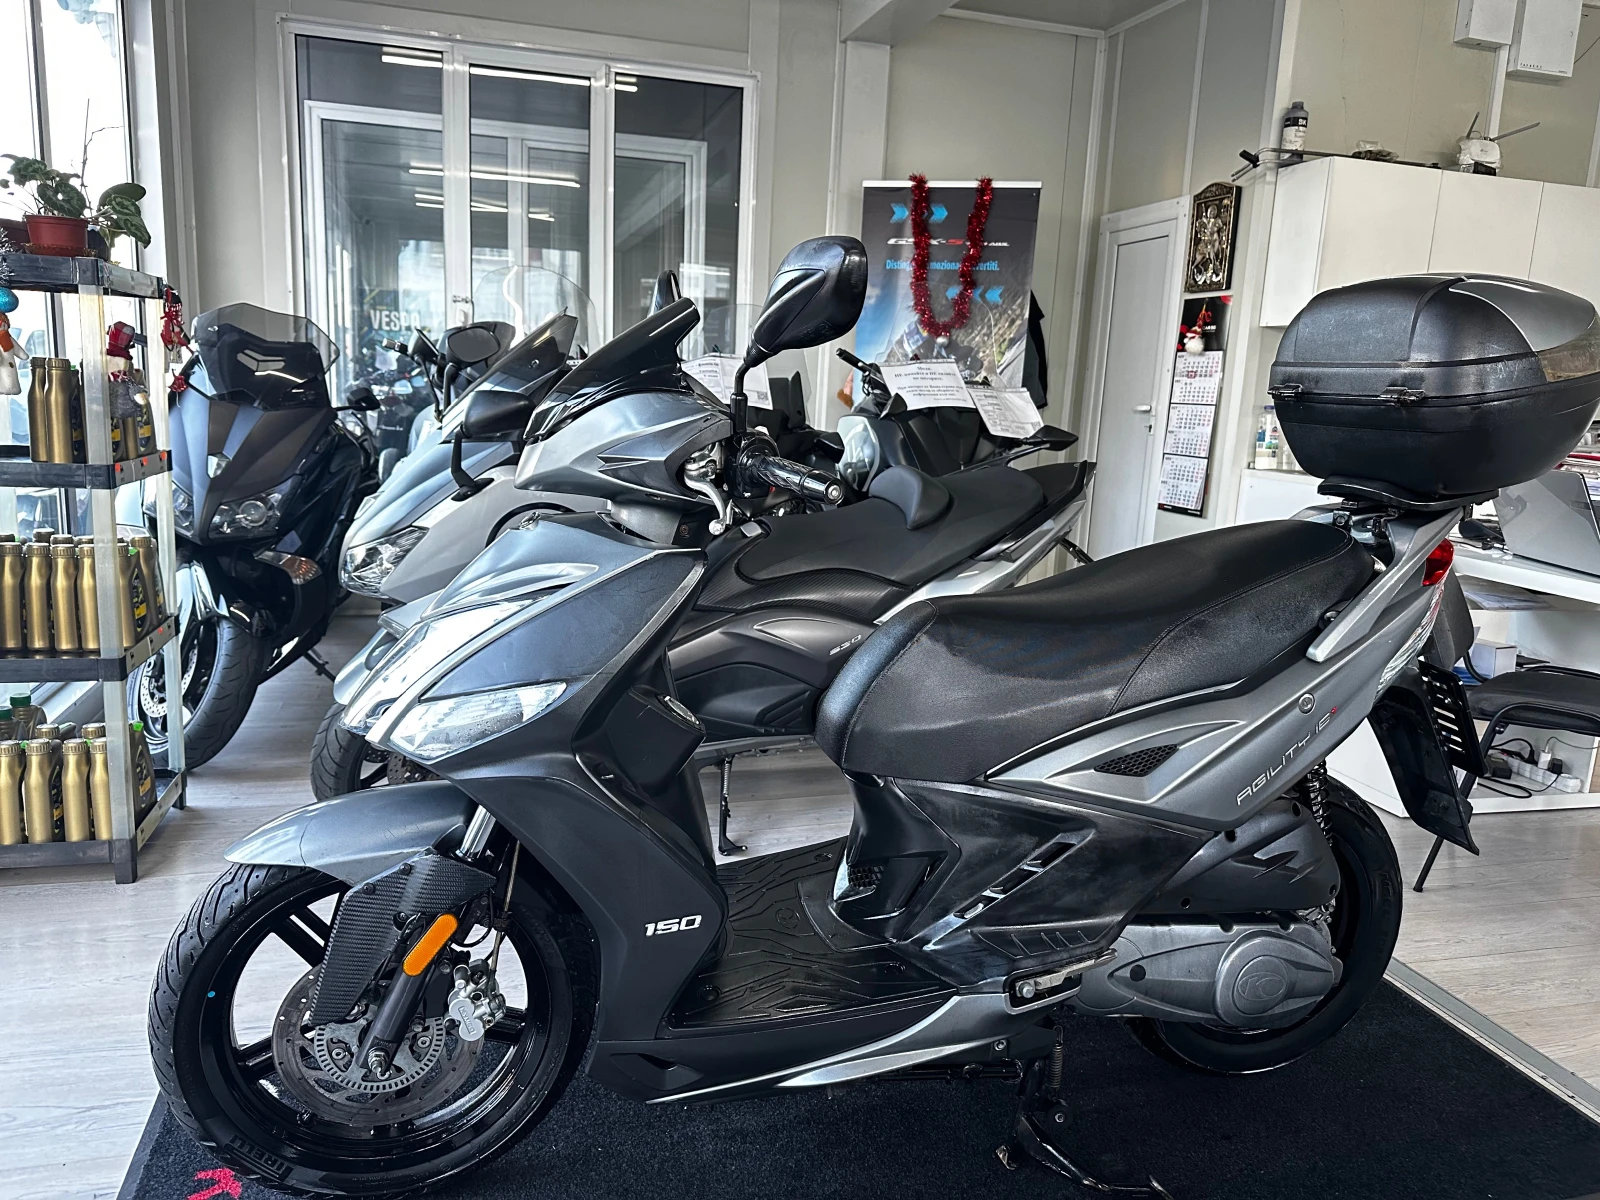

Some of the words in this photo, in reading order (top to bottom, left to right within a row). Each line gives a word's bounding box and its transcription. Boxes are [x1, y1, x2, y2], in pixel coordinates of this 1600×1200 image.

[369, 309, 420, 331] VESPA
[1236, 731, 1311, 806] AGILITY
[644, 914, 702, 937] 150
[223, 1134, 295, 1184] PIRELLI
